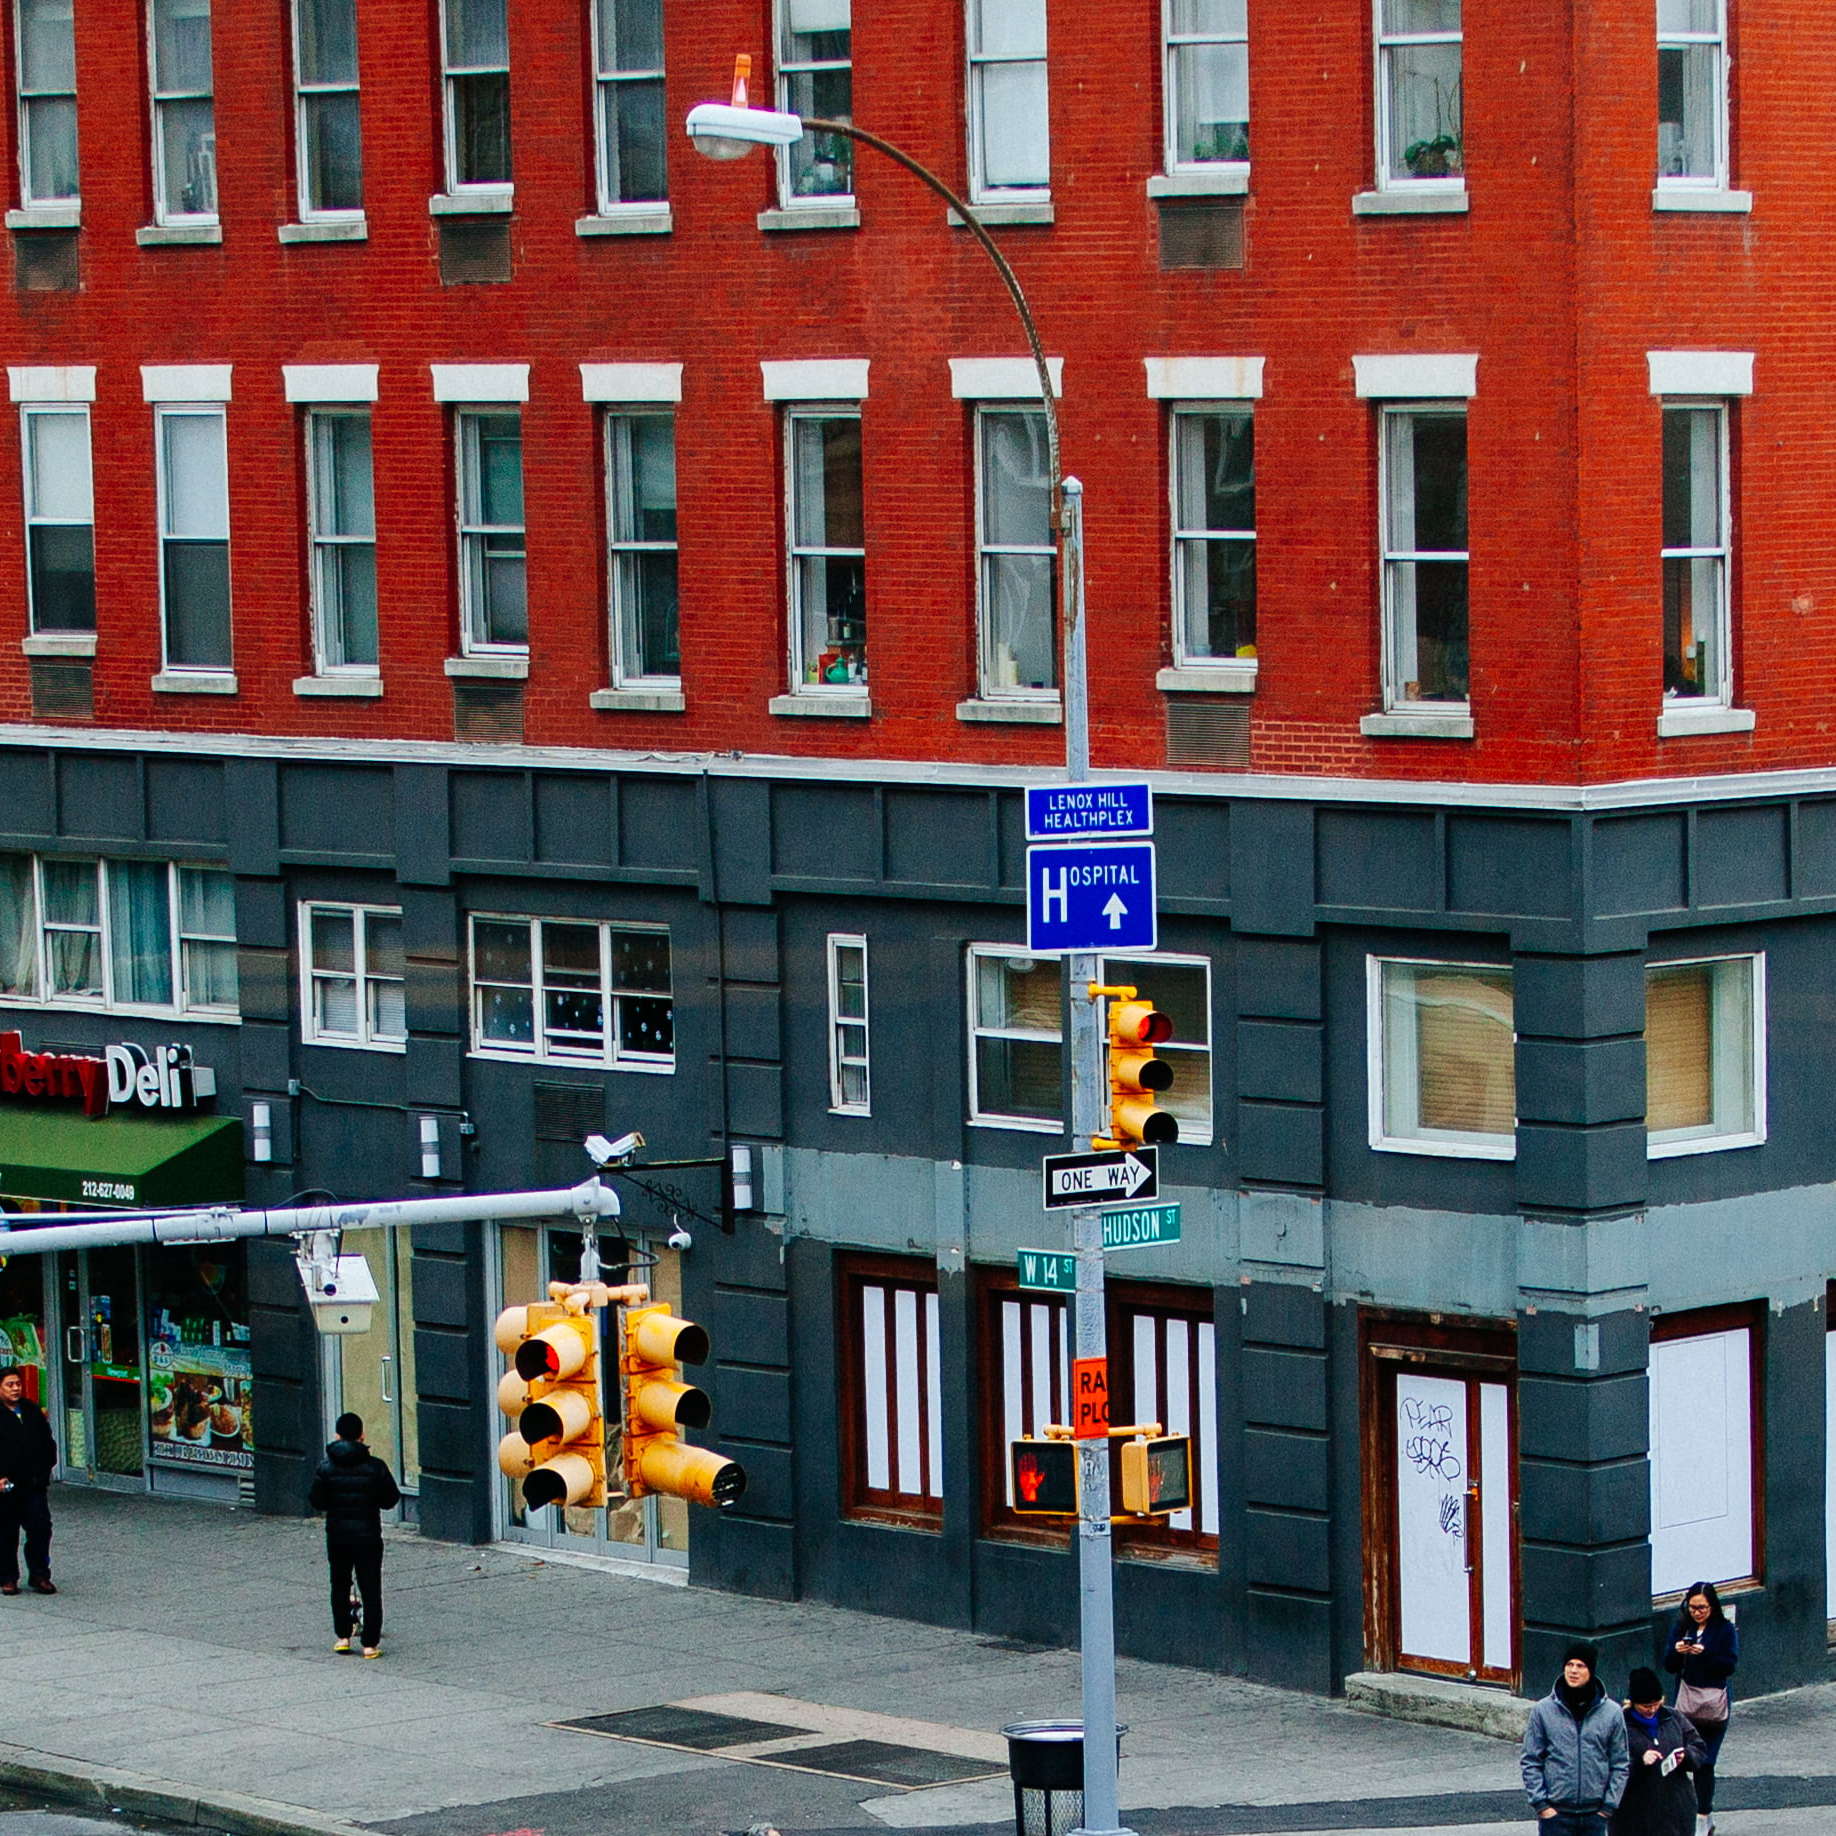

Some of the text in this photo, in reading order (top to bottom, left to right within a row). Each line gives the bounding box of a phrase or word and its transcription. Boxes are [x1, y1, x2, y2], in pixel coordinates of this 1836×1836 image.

[1049, 792, 1128, 810] LENOX HILL
[1044, 810, 1134, 829] HEALTHPLEX
[1042, 864, 1140, 923] HOSPITAL
[105, 1044, 183, 1108] Deli
[82, 1181, 135, 1201] 212-627-0049
[1061, 1164, 1141, 1191] ONE WAY
[1103, 1207, 1177, 1245] HUDSON ST
[1024, 1255, 1075, 1285] W 14 ST
[1081, 1403, 1108, 1425] PLO
